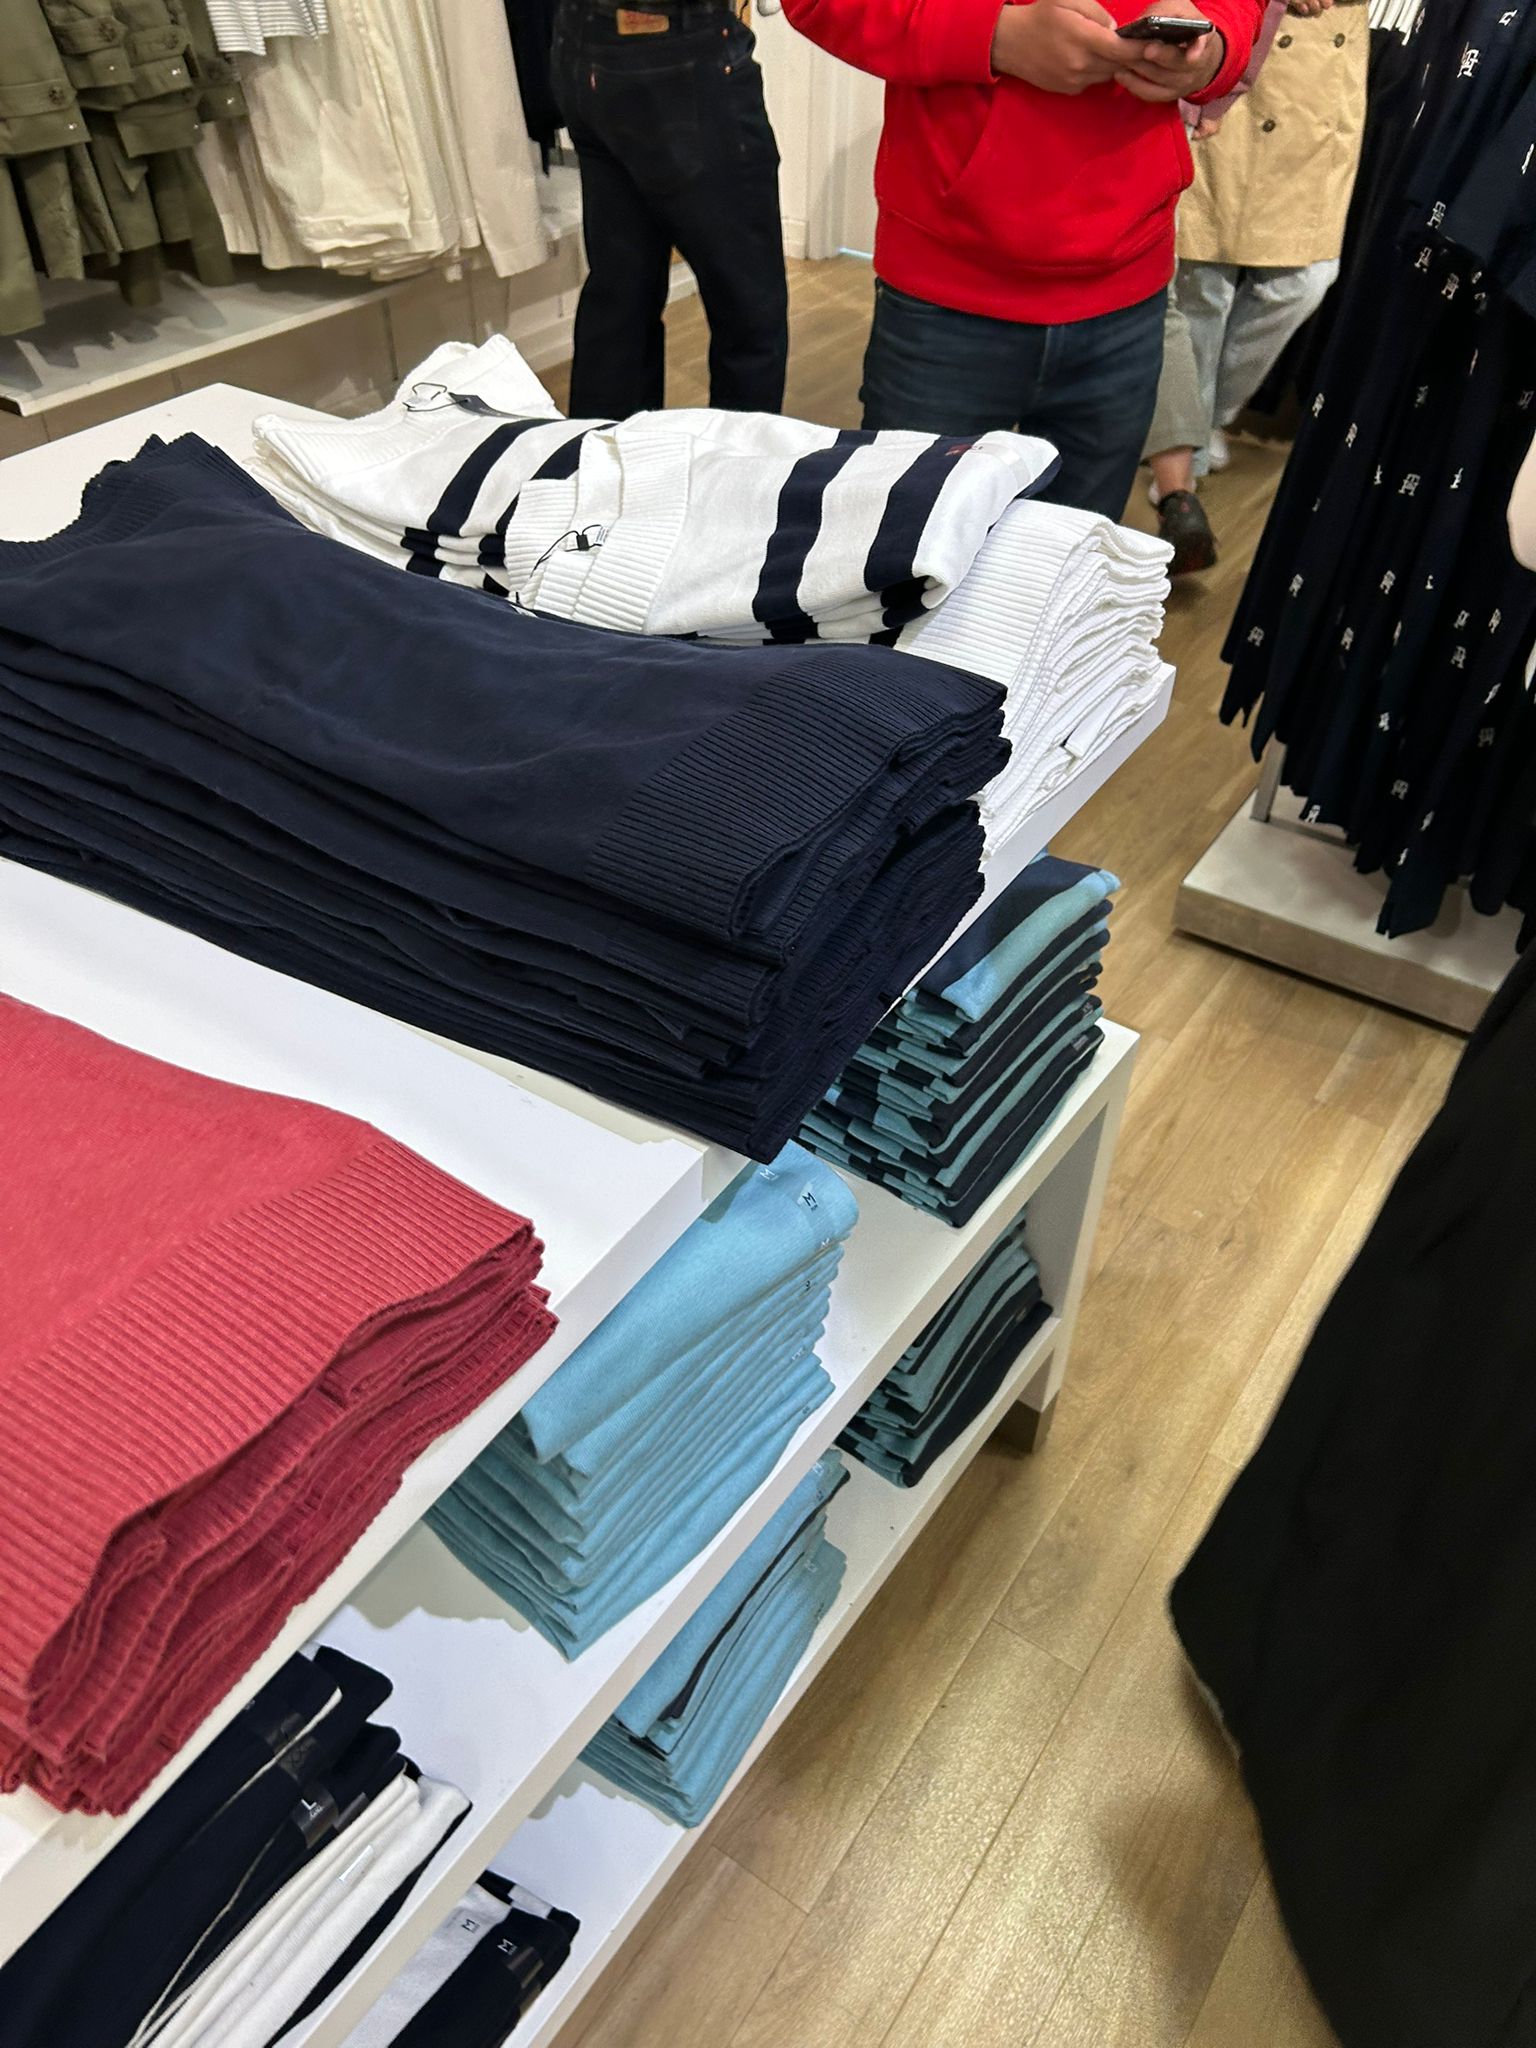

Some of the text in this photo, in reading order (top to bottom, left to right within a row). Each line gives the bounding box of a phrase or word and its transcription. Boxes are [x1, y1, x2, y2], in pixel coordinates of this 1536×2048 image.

[759, 1168, 776, 1181] M
[802, 1192, 817, 1207] M
[461, 1918, 476, 1933] M
[497, 1938, 514, 1953] M
